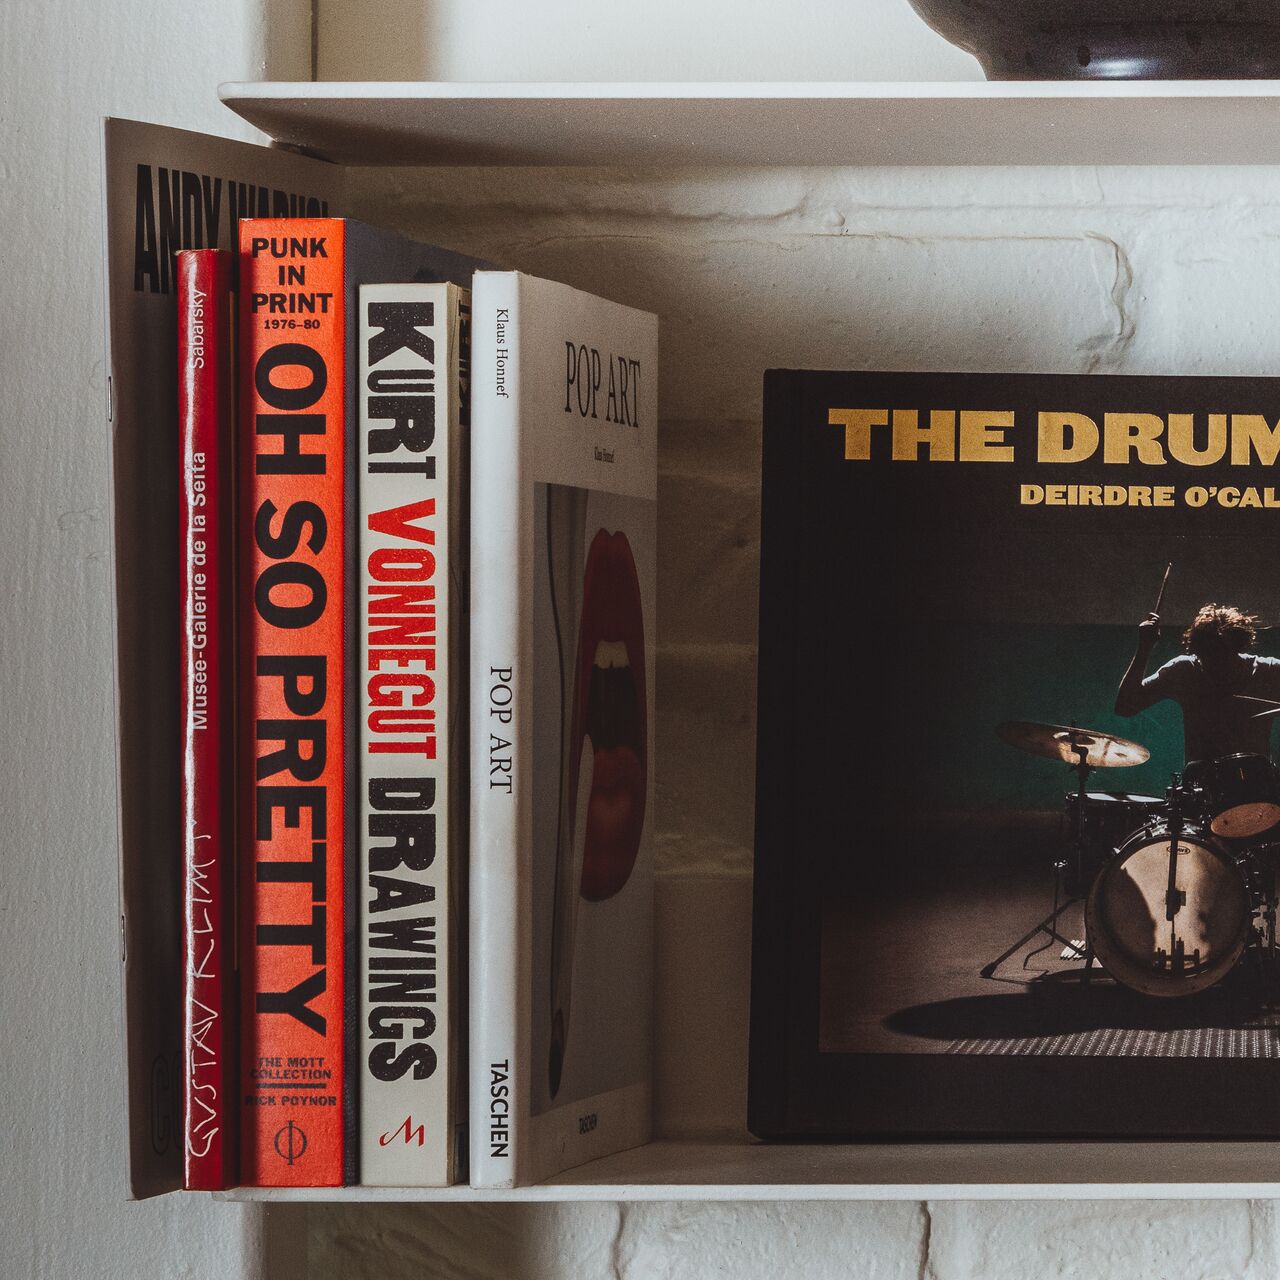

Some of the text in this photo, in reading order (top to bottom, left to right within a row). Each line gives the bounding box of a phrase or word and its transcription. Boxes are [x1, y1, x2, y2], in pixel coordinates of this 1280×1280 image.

[251, 237, 328, 259] PUNK
[278, 265, 306, 286] IN
[251, 292, 333, 314] PRINT
[186, 289, 207, 369] Sabarsky
[496, 308, 509, 399] Klaus Honnef
[564, 340, 601, 418] POP
[605, 352, 641, 428] ART
[828, 408, 1015, 462] THE
[1020, 484, 1176, 508] DEIRDRE
[193, 540, 207, 566] de
[254, 342, 328, 1037] OH SO PRETTY
[367, 301, 438, 1083] KURT VONNEGUT DRAWINGS
[489, 666, 513, 794] POP ART
[250, 1069, 331, 1080] COLLECTION
[257, 1057, 325, 1068] THE MOTT
[282, 1095, 337, 1107] POYNOR
[490, 1059, 509, 1157] TASCHEN
